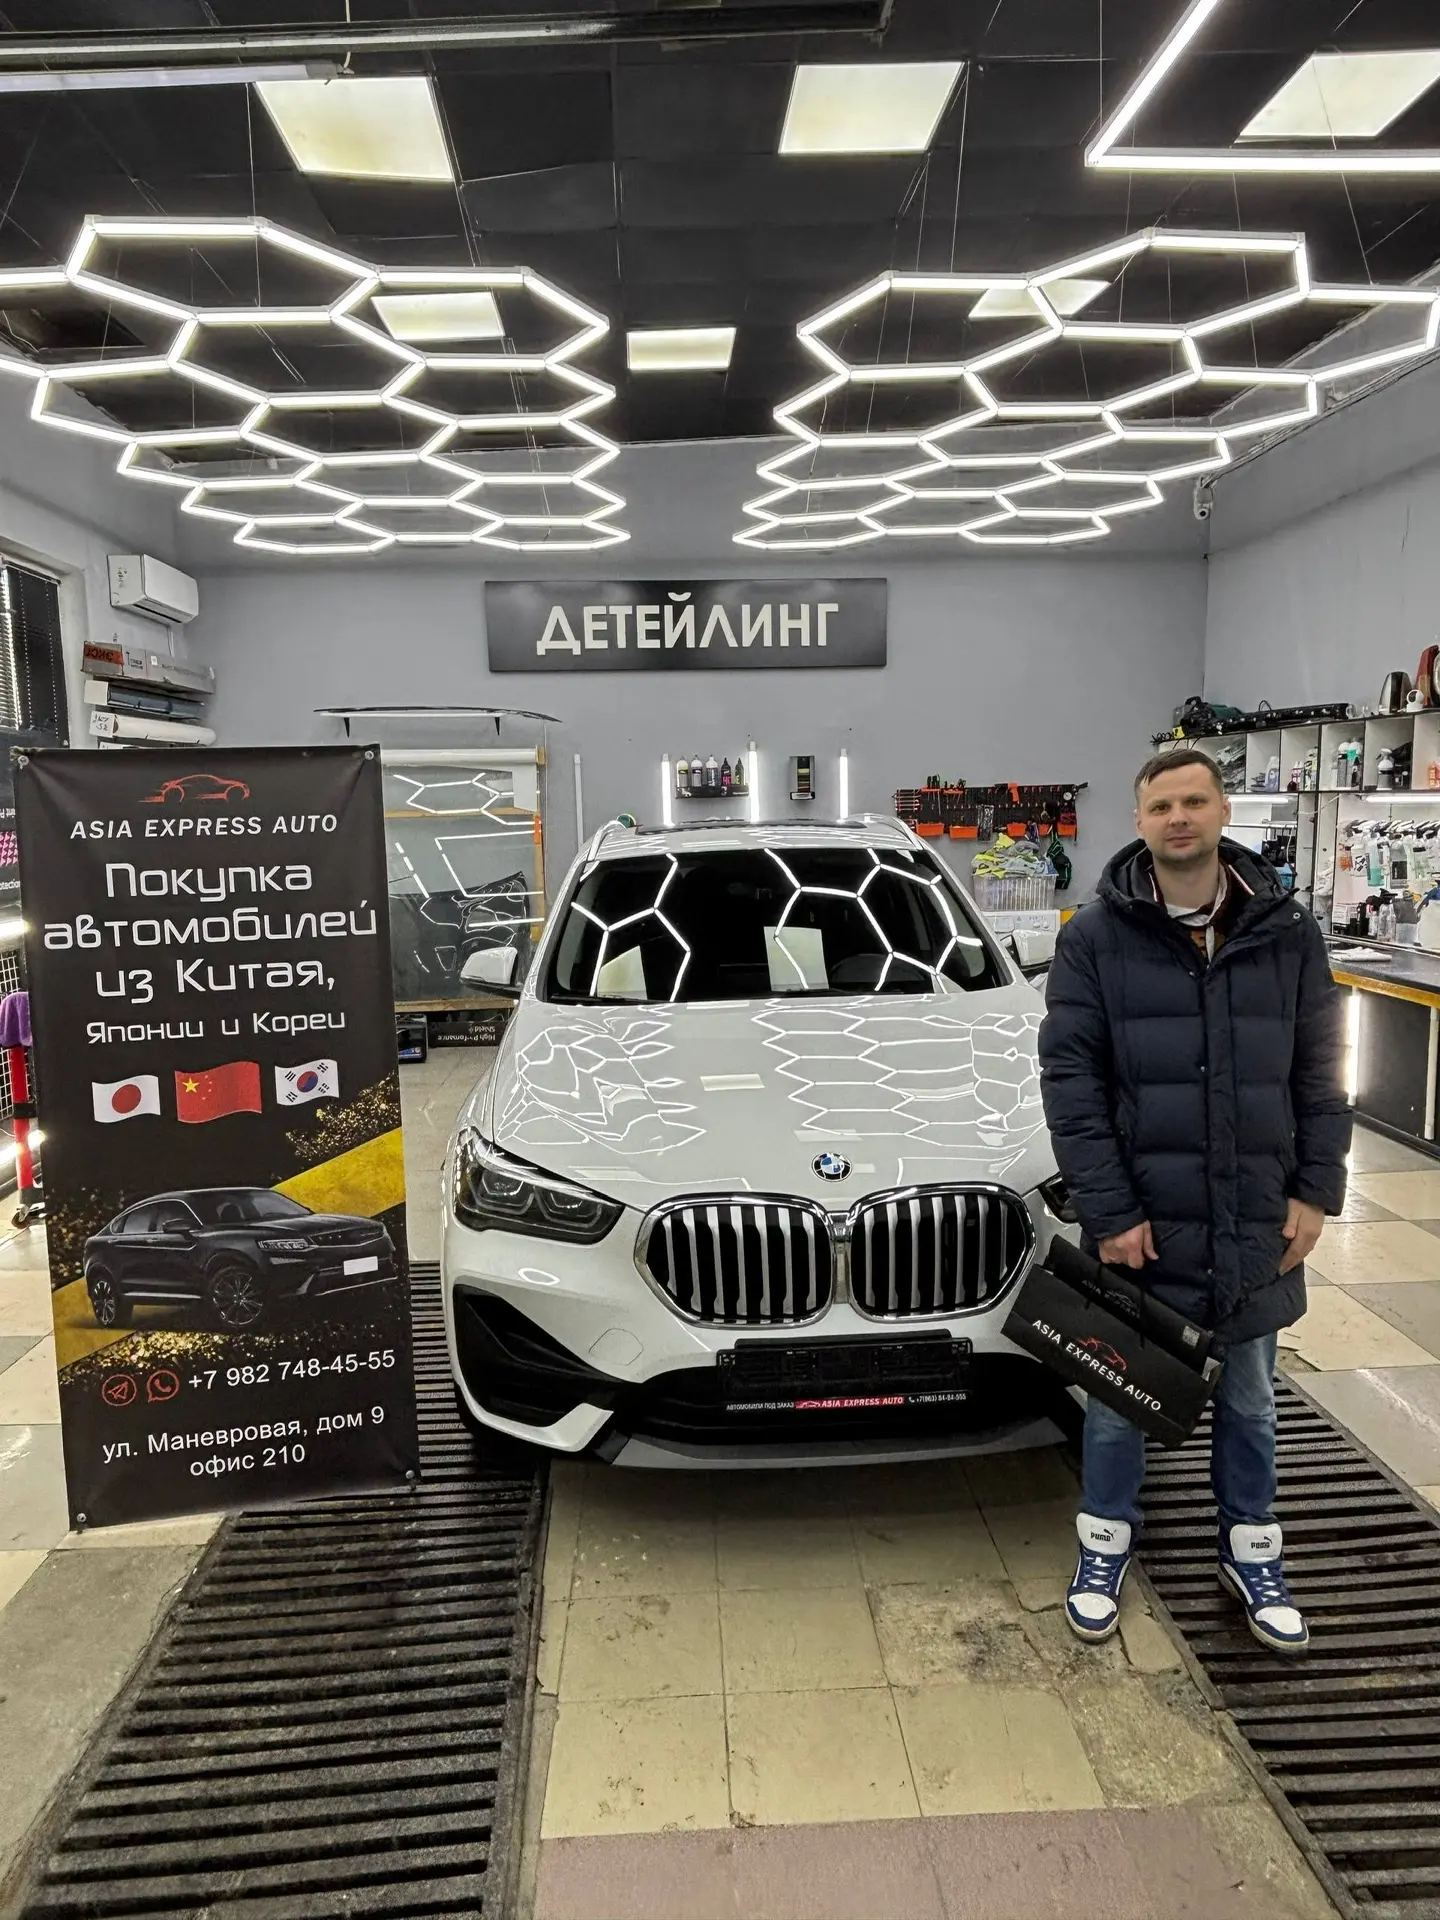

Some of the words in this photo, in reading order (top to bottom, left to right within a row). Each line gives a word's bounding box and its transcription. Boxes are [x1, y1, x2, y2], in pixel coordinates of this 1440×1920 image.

[536, 592, 839, 656] ДЕТЕЙЛИНГ
[70, 820, 133, 840] ASIA
[144, 816, 262, 838] EXPRESS
[272, 814, 338, 834] AUTO
[106, 862, 312, 903] Покупка
[44, 899, 377, 950] автомобилей
[95, 969, 154, 1004] из
[176, 958, 335, 993] Китая,
[86, 1020, 204, 1044] Японии
[221, 1018, 239, 1035] и
[253, 1011, 345, 1037] Кореи
[188, 1371, 216, 1391] +7
[226, 1364, 270, 1387] 982
[278, 1349, 396, 1380] 748-45-55
[1032, 1319, 1061, 1345] ASIA
[1065, 1343, 1124, 1386] EXPRESS
[1124, 1384, 1161, 1411] AUTO
[820, 1400, 841, 1408] ASIA
[844, 1398, 880, 1407] EXPRESS
[882, 1396, 904, 1405] AUTO
[102, 1441, 138, 1464] ул.
[148, 1419, 308, 1454] Маневровая,
[316, 1410, 363, 1436] дом
[371, 1406, 386, 1424] 9
[189, 1455, 255, 1478] офис
[263, 1444, 306, 1467] 210
[1090, 1531, 1111, 1542] PUMA
